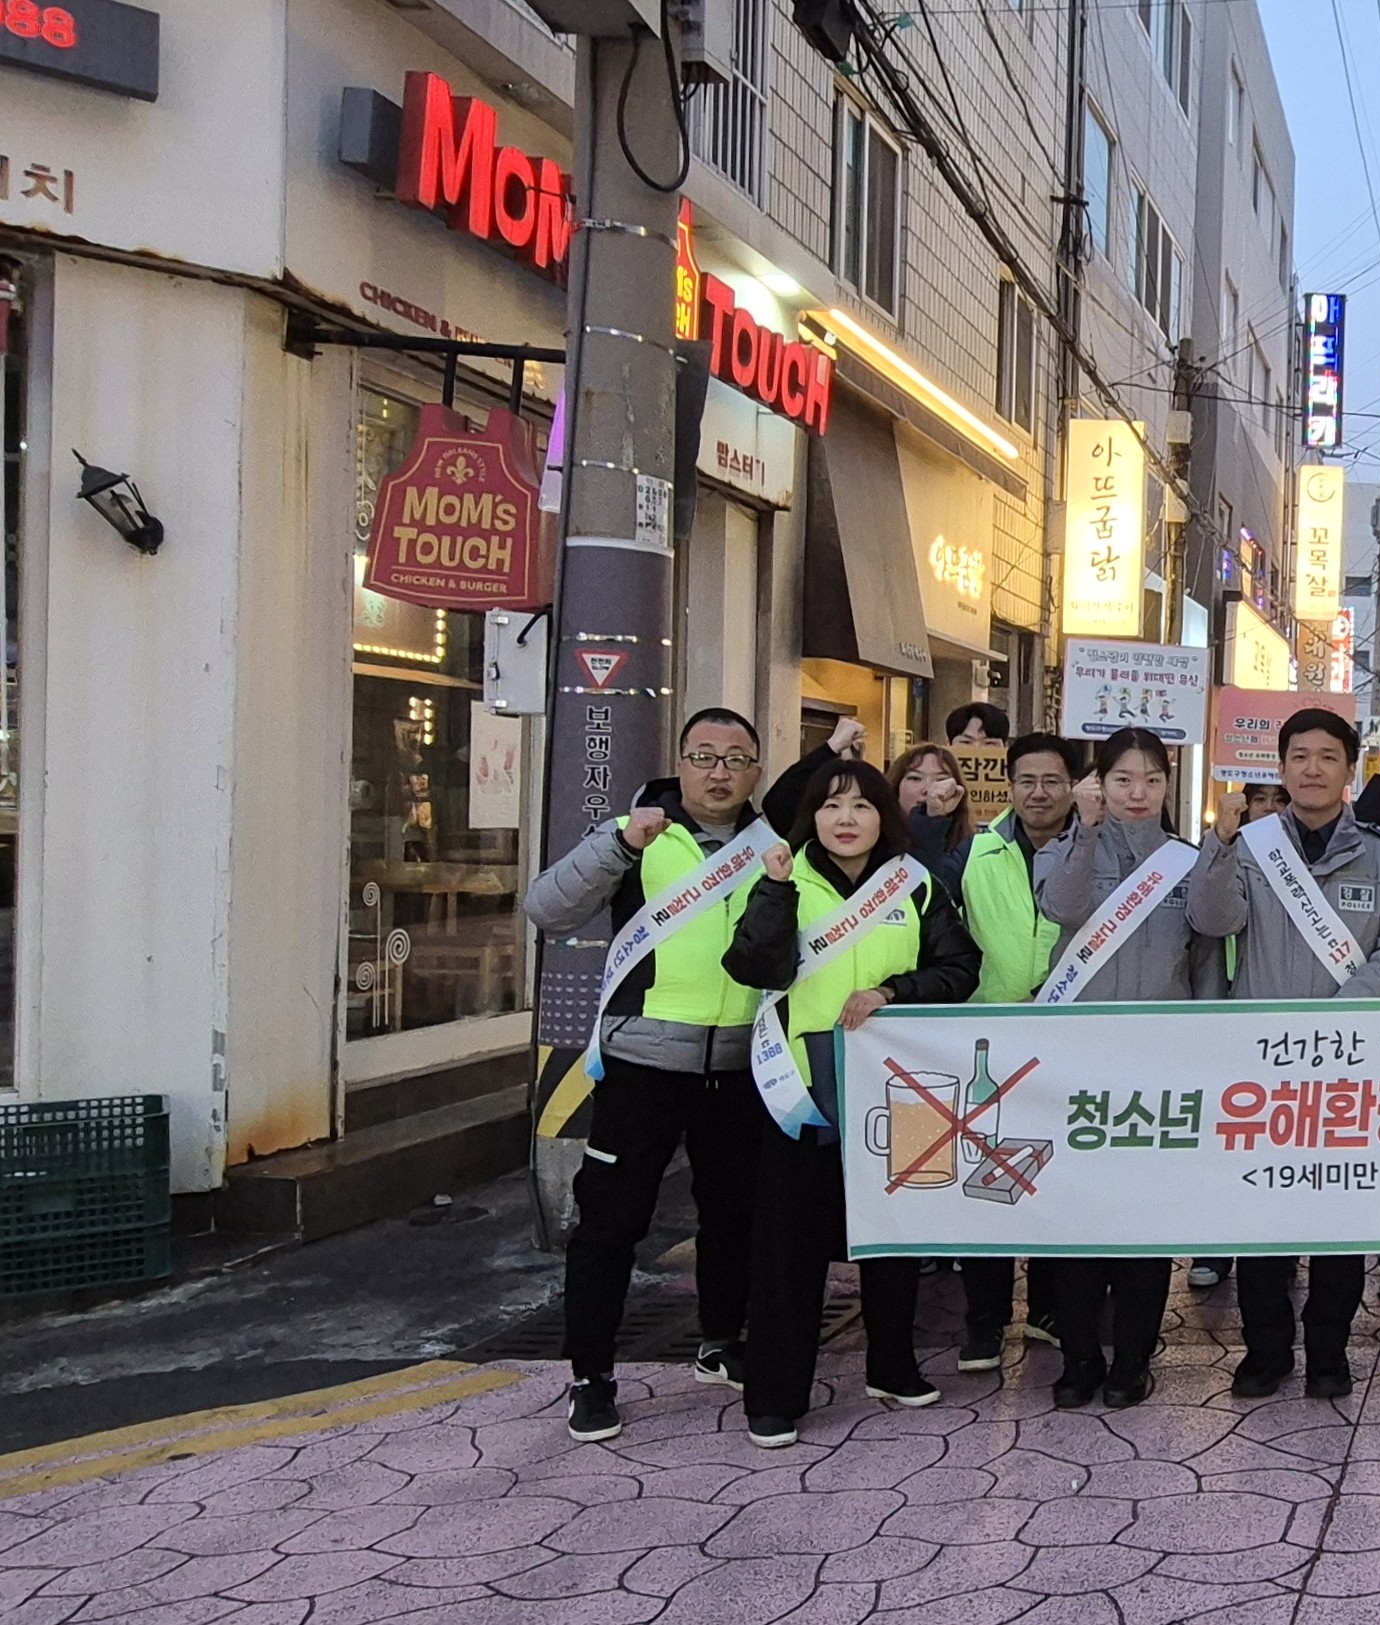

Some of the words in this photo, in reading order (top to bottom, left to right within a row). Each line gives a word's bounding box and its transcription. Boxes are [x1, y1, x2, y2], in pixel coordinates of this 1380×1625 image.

[360, 281, 438, 333] CHICKEN
[705, 272, 832, 437] TOUCH
[393, 526, 513, 573] TOUCH
[390, 573, 446, 588] CHICKEN
[459, 580, 508, 594] BURGER
[1234, 717, 1271, 731] 우리의
[582, 705, 613, 840] 보행자우
[958, 757, 1008, 783] 잠깐
[651, 887, 701, 927] 근절로
[859, 867, 908, 918] 유해환경
[1115, 872, 1163, 921] 유해환경
[1268, 848, 1331, 941] 학교폭력신고는
[1329, 941, 1350, 964] 117
[1341, 901, 1370, 910] POLICE
[808, 915, 859, 955] 근절로
[1076, 919, 1117, 964] 근절로
[756, 1042, 783, 1065] 1388
[1256, 1029, 1366, 1067] 건강한
[1066, 1088, 1202, 1150] 청소년
[1241, 1161, 1379, 1191] <19세미만
